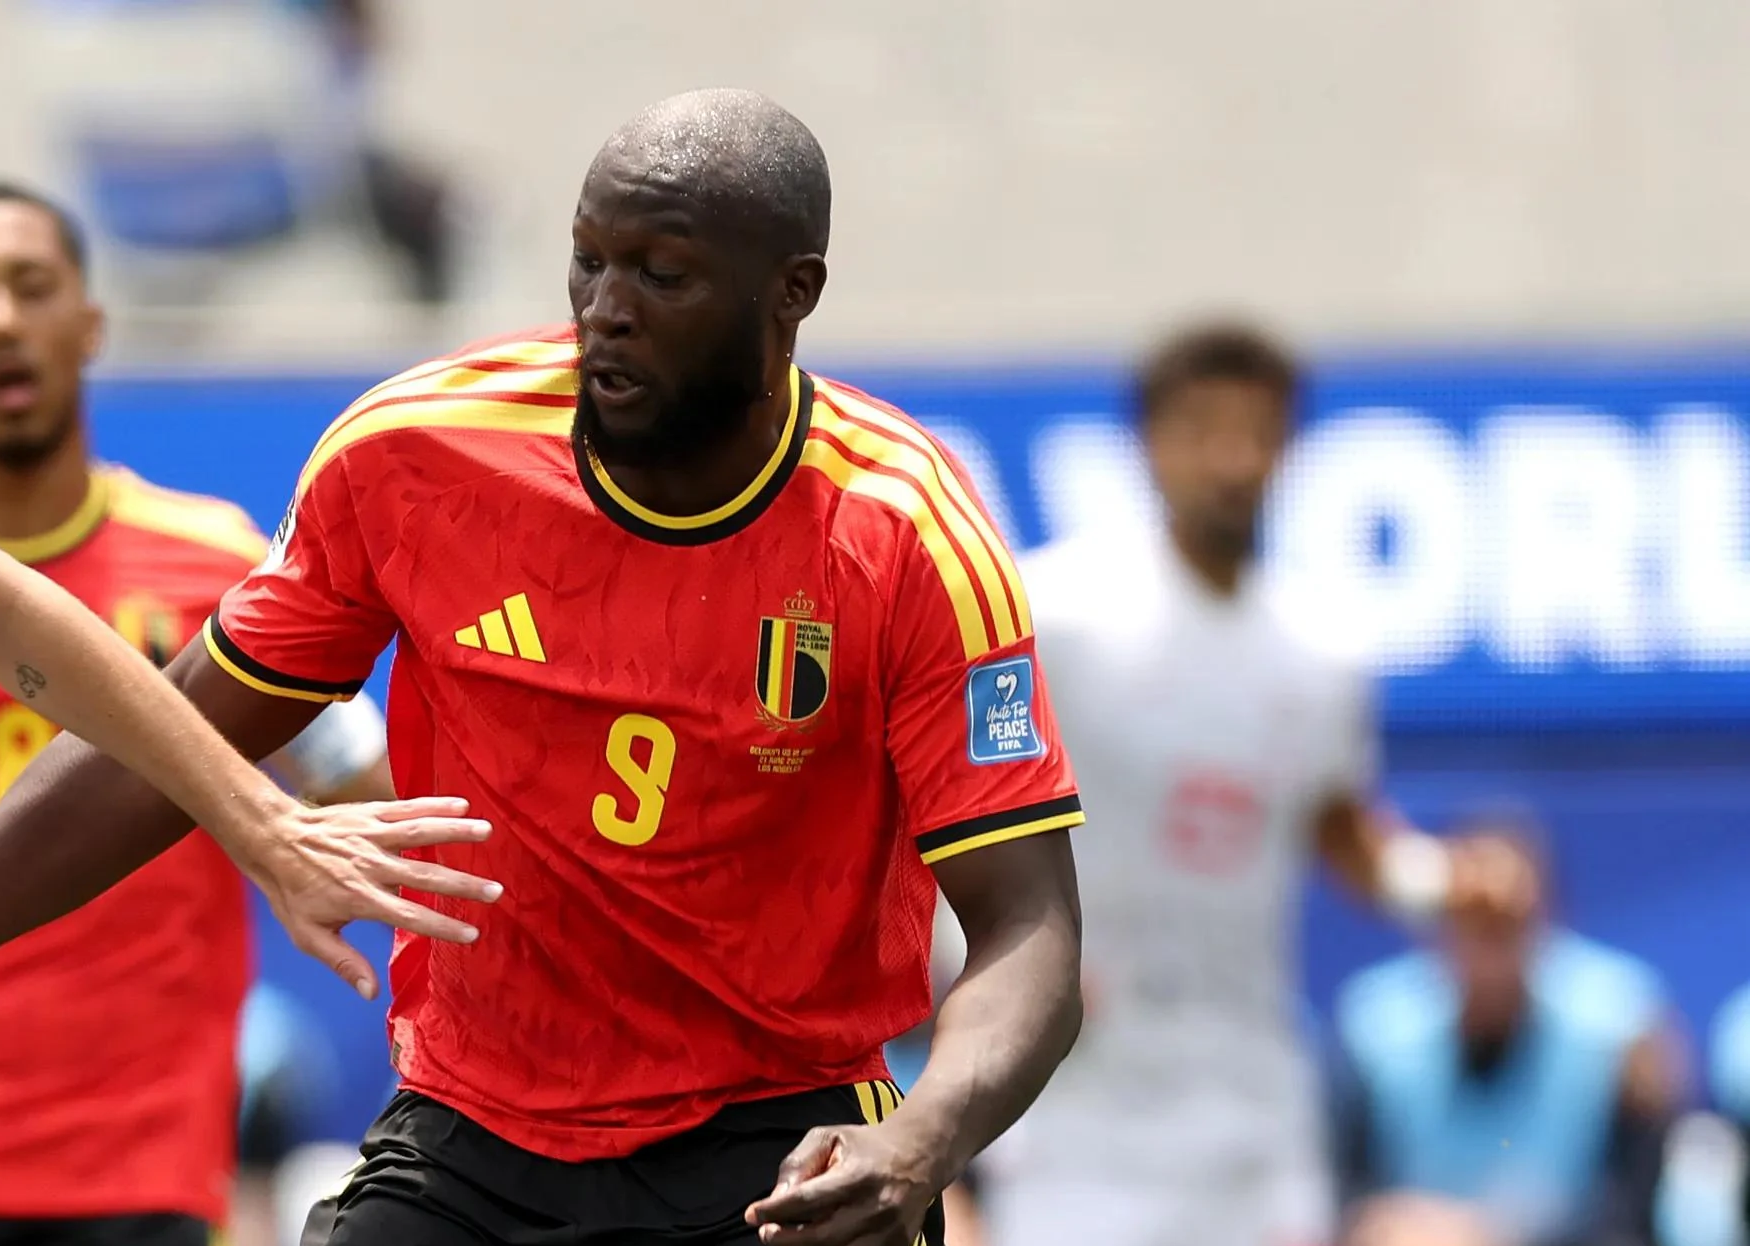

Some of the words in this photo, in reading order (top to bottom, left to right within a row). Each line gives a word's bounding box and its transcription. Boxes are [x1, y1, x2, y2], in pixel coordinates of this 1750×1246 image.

[797, 623, 822, 633] ROYAL
[796, 632, 830, 642] BELGIAN
[989, 719, 1028, 740] PEACE
[997, 739, 1022, 751] FIFA
[592, 713, 676, 846] 9
